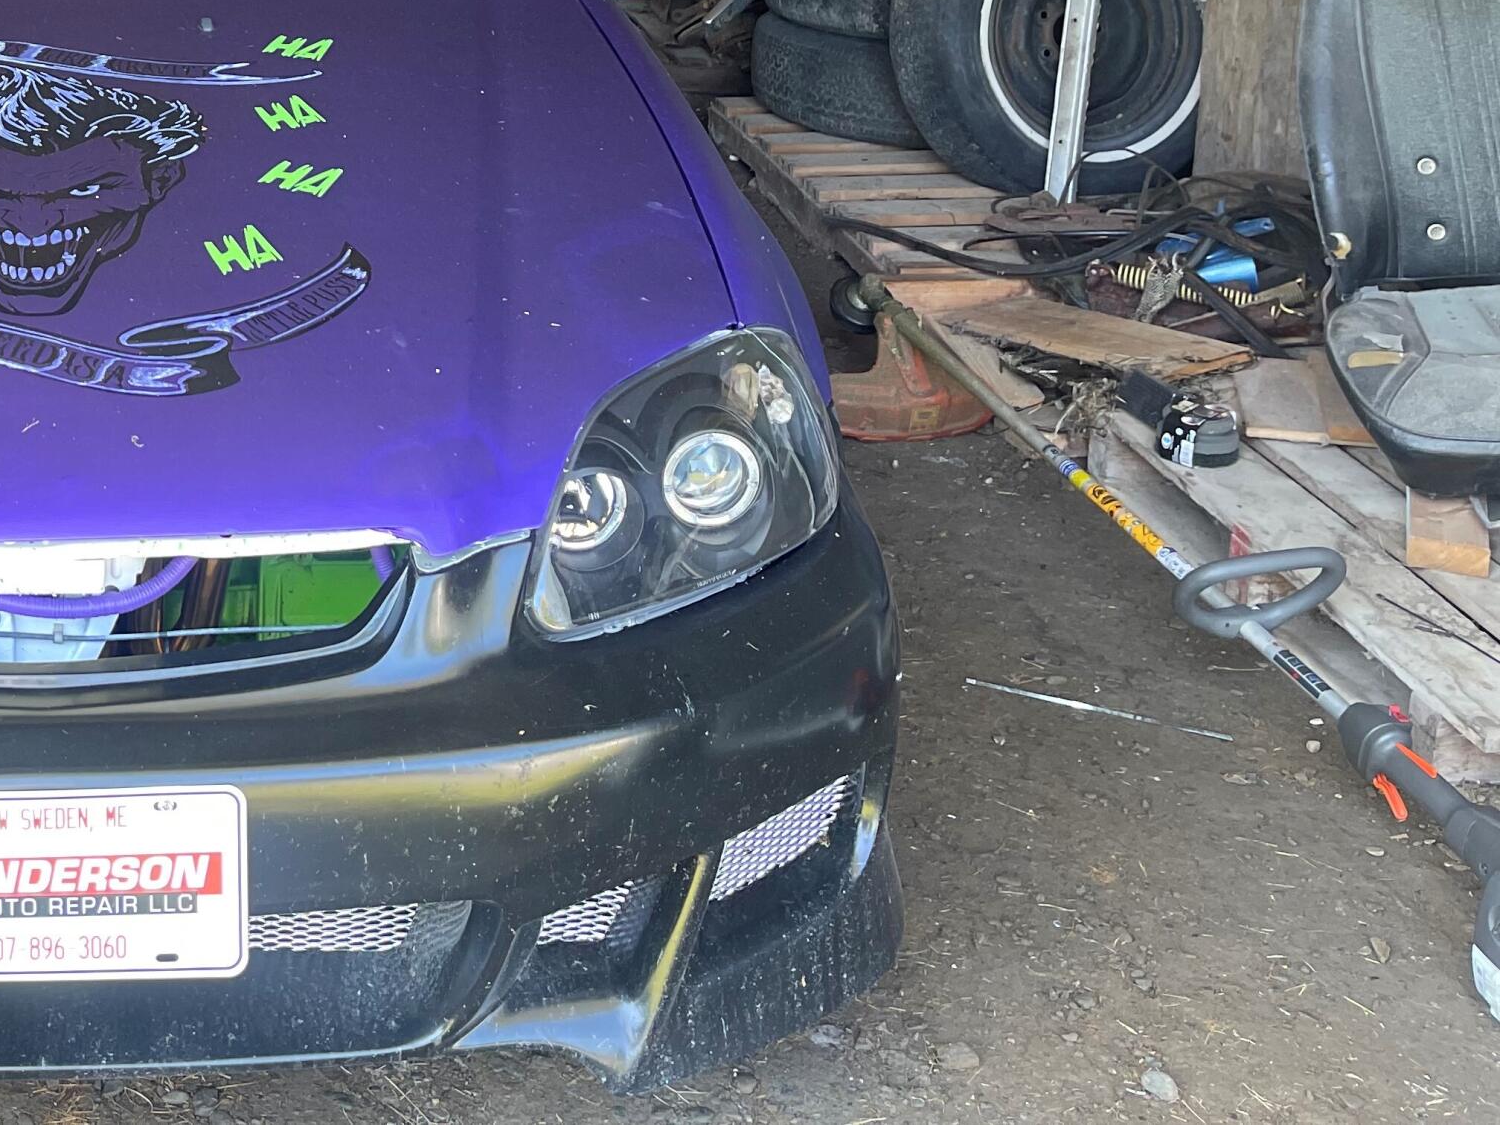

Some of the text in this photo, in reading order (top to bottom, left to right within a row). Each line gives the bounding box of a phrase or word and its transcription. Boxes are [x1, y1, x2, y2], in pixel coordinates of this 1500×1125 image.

[263, 34, 333, 62] HA
[255, 94, 326, 132] HA
[257, 159, 343, 197] HA
[203, 225, 283, 275] HA
[63, 349, 99, 383] IS
[100, 363, 127, 389] A
[20, 806, 94, 833] SWEDEN,
[105, 805, 128, 828] ME
[48, 895, 139, 916] REPAIR
[148, 893, 195, 913] LLC
